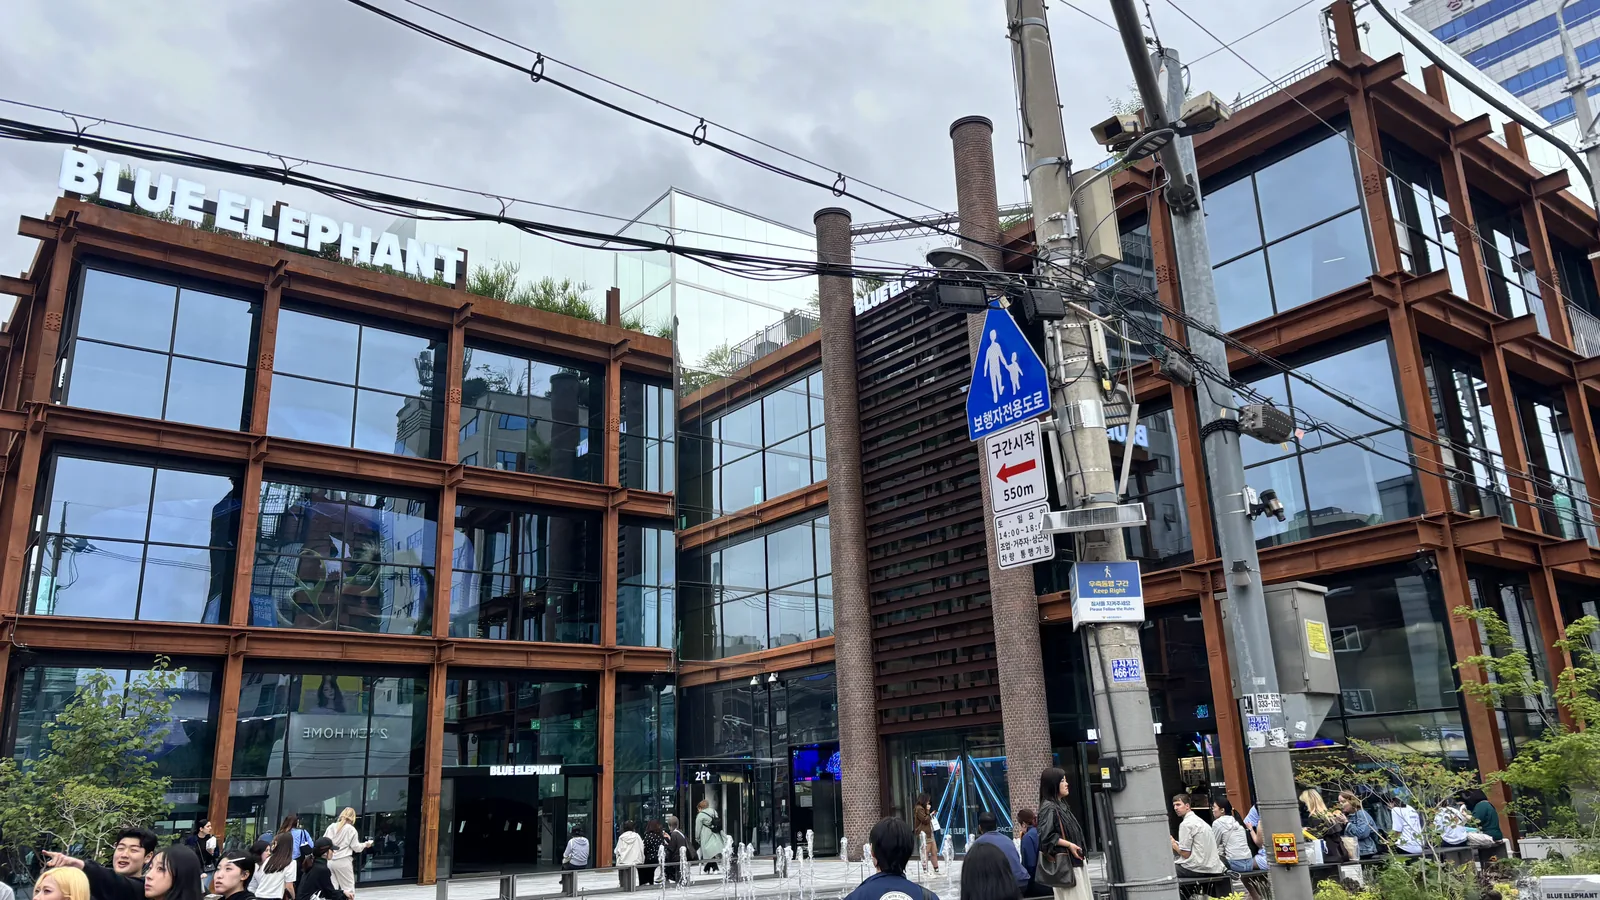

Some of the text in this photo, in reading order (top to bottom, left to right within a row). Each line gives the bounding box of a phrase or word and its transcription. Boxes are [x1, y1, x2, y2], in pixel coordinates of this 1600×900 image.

[58, 149, 465, 285] BLUE ELEPHANT
[855, 285, 890, 316] BLUE
[973, 390, 1045, 433] 보행자전용도로
[992, 430, 1035, 459] 구간시작
[1004, 484, 1034, 501] 550m
[1001, 552, 1015, 562] 차량
[489, 765, 562, 776] BLUE ELEPHANT
[695, 771, 705, 780] 2F
